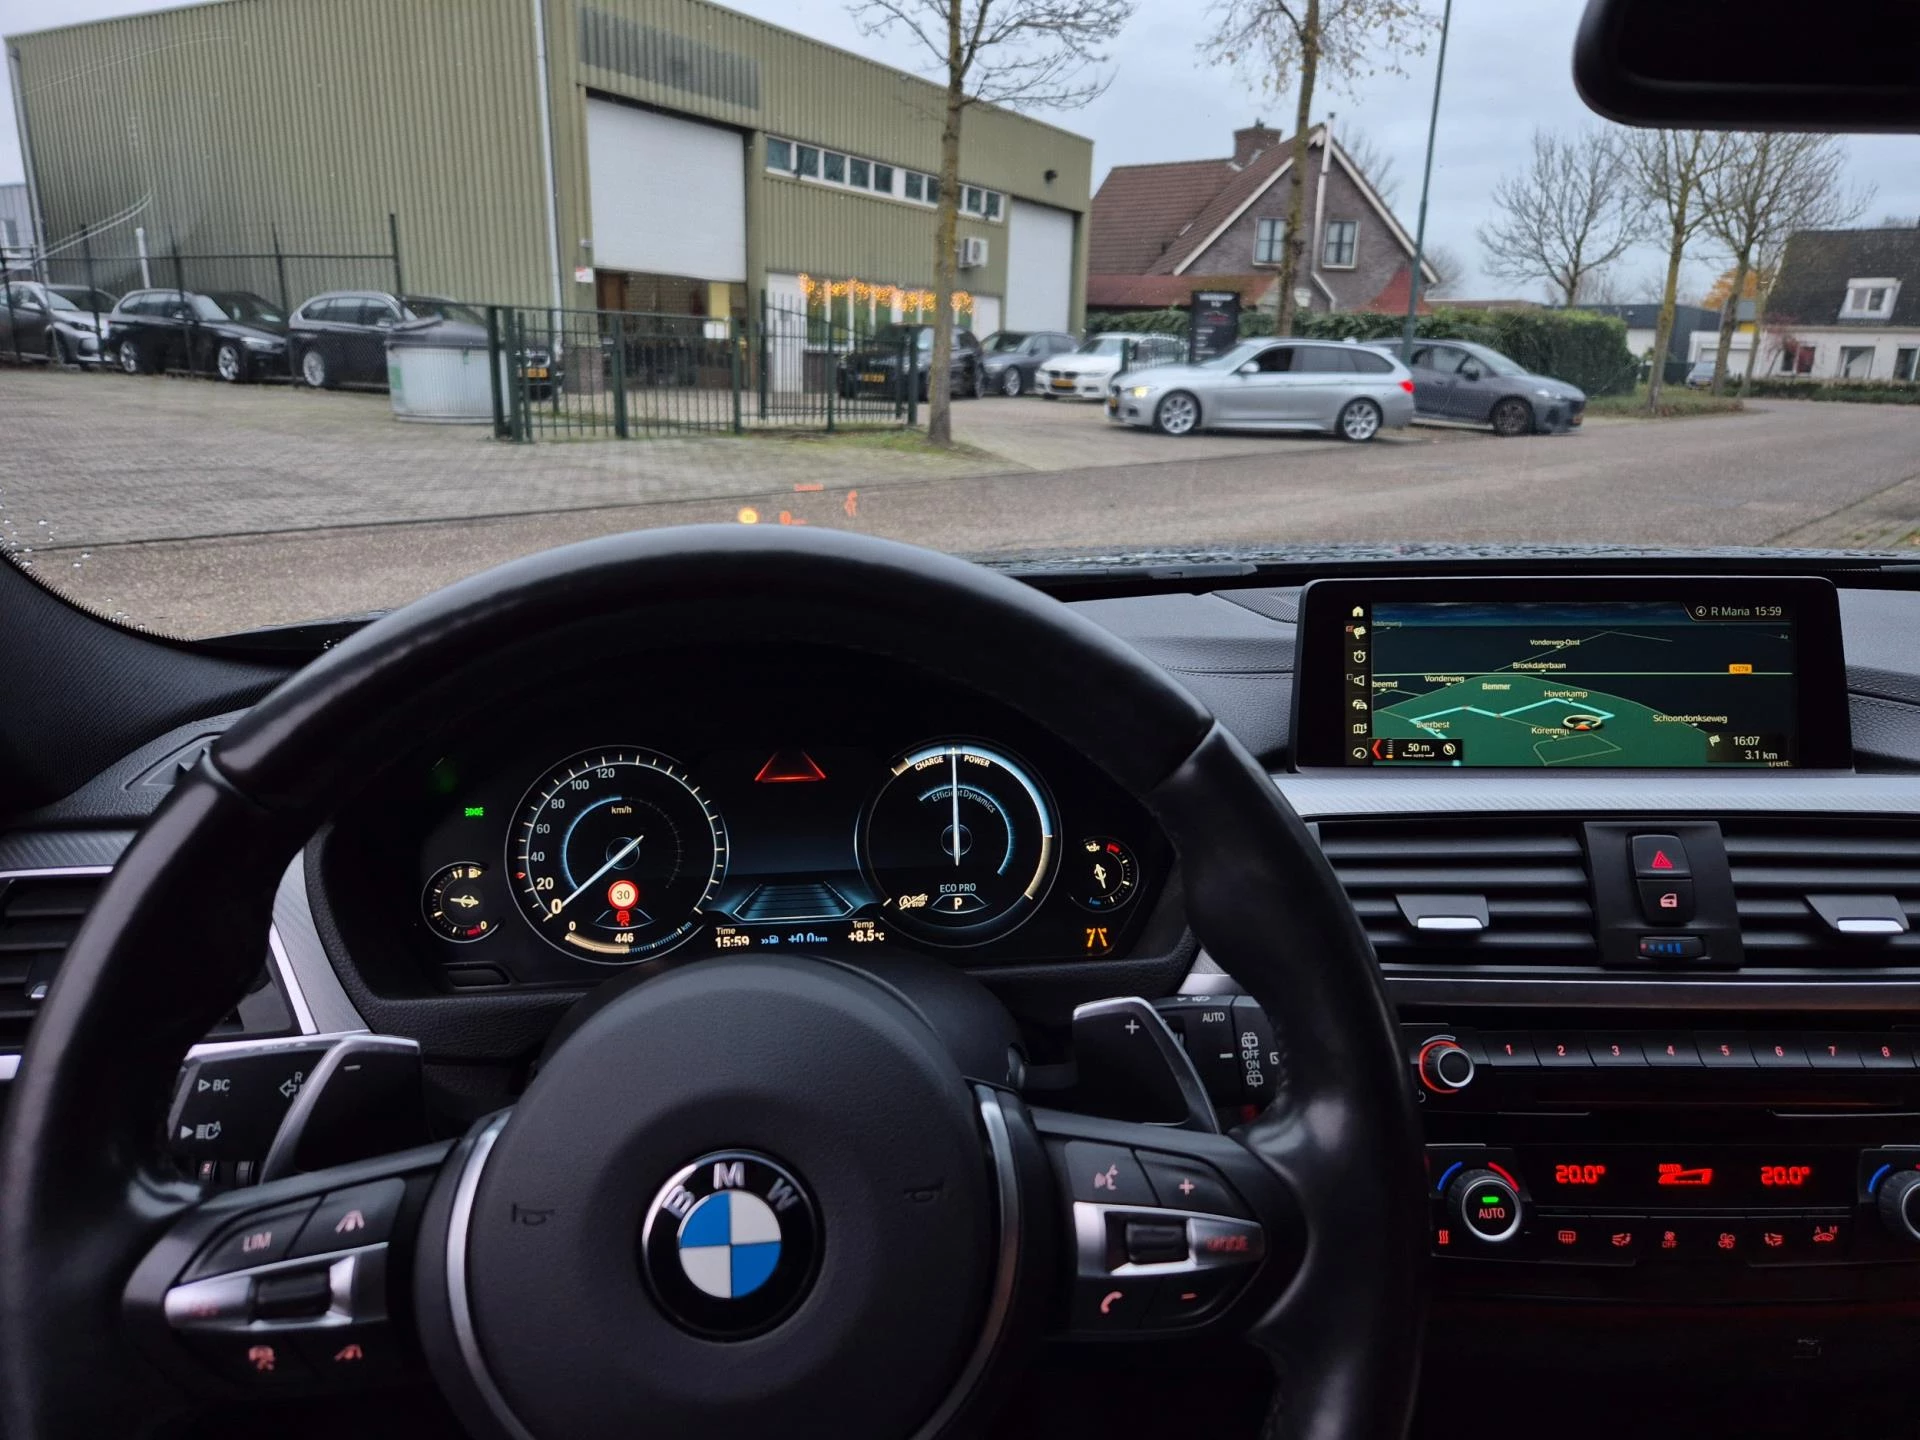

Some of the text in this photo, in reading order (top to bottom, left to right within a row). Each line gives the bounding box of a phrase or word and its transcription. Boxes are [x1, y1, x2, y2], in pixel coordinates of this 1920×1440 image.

[1754, 606, 1782, 617] 15:59
[1424, 675, 1465, 683] Vonderweg
[1544, 690, 1588, 699] Haverkamp
[1652, 714, 1728, 724] Schoondonkseweg
[1733, 735, 1760, 746] 16:07
[1407, 743, 1430, 752] 50 m
[1744, 750, 1778, 760] 3.1 km
[915, 755, 944, 771] CHARGE
[963, 754, 991, 768] POWER
[595, 767, 615, 779] 120
[570, 779, 590, 791] 100
[551, 798, 565, 809] 80
[611, 805, 632, 815] km/h
[536, 823, 550, 834] 60
[530, 851, 545, 862] 40
[536, 876, 554, 890] 20
[940, 883, 977, 893] ECO PRO
[616, 890, 630, 900] 30
[551, 898, 562, 914] 0
[954, 897, 963, 910] P
[480, 920, 487, 930] 0
[568, 921, 576, 931] 0
[853, 920, 875, 930] Temp
[715, 927, 736, 936] Time
[615, 932, 634, 943] 446
[714, 935, 750, 949] 15:59
[1201, 1011, 1226, 1023] AUTO
[1242, 1050, 1260, 1060] OFF
[1505, 1045, 1890, 1057] 1 2 3 4 5 6 7 8
[1246, 1060, 1261, 1069] ON
[212, 1079, 231, 1091] BC
[662, 1161, 799, 1219] BMW
[1478, 1207, 1505, 1220] AUTO
[1661, 1240, 1677, 1248] OFF
